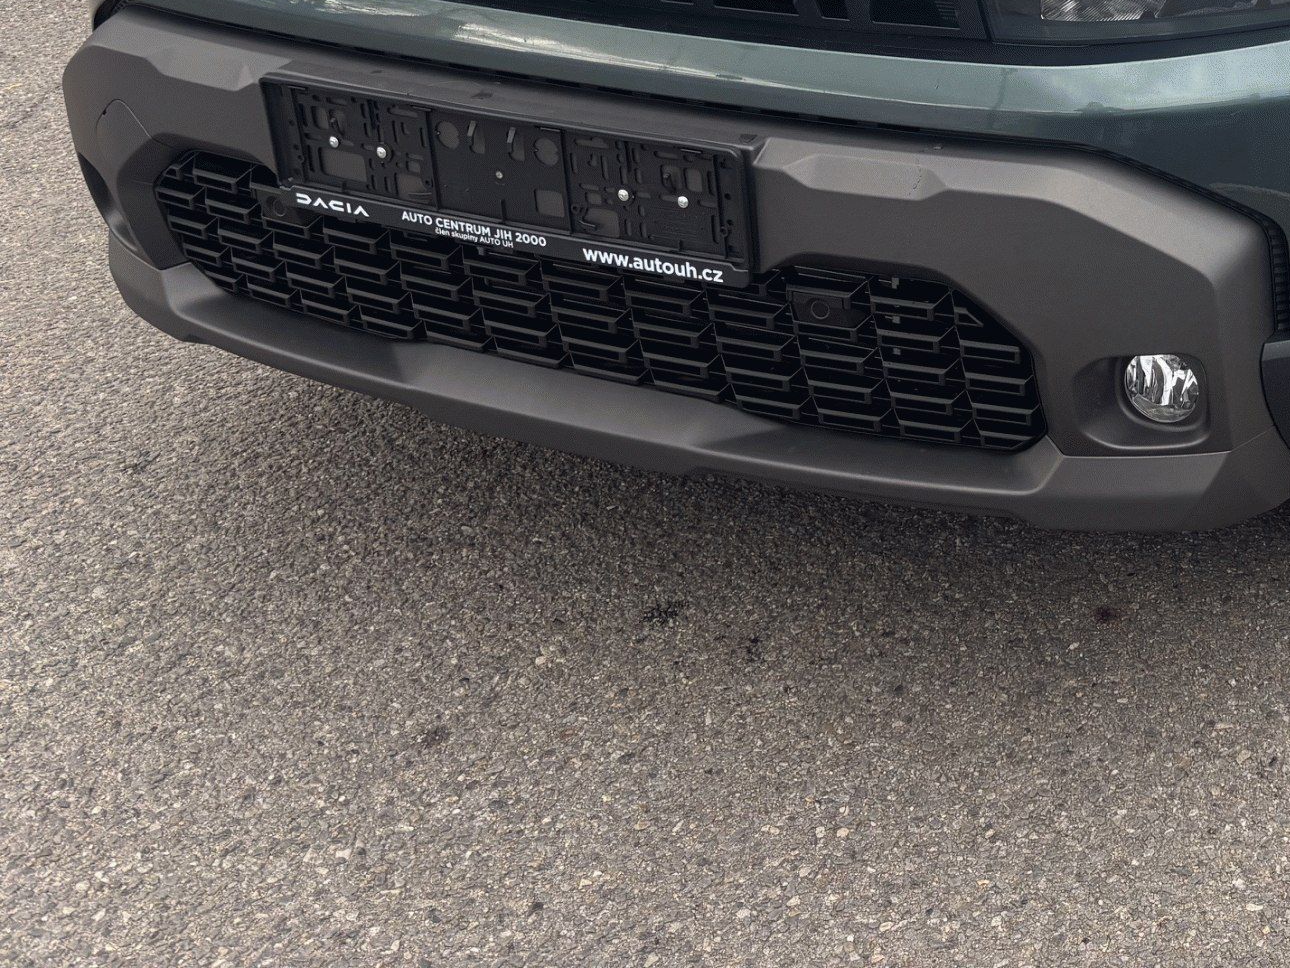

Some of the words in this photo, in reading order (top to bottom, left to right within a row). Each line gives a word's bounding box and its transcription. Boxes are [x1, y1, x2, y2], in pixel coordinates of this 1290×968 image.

[296, 192, 370, 218] DACIA
[401, 210, 433, 226] AUTO
[435, 217, 491, 238] CENTRUM
[494, 226, 512, 241] JIH
[515, 232, 547, 247] 2000
[451, 231, 478, 243] skupiny
[479, 236, 501, 246] AUTO
[502, 239, 514, 249] UH
[582, 247, 724, 283] www.autouh.cz
